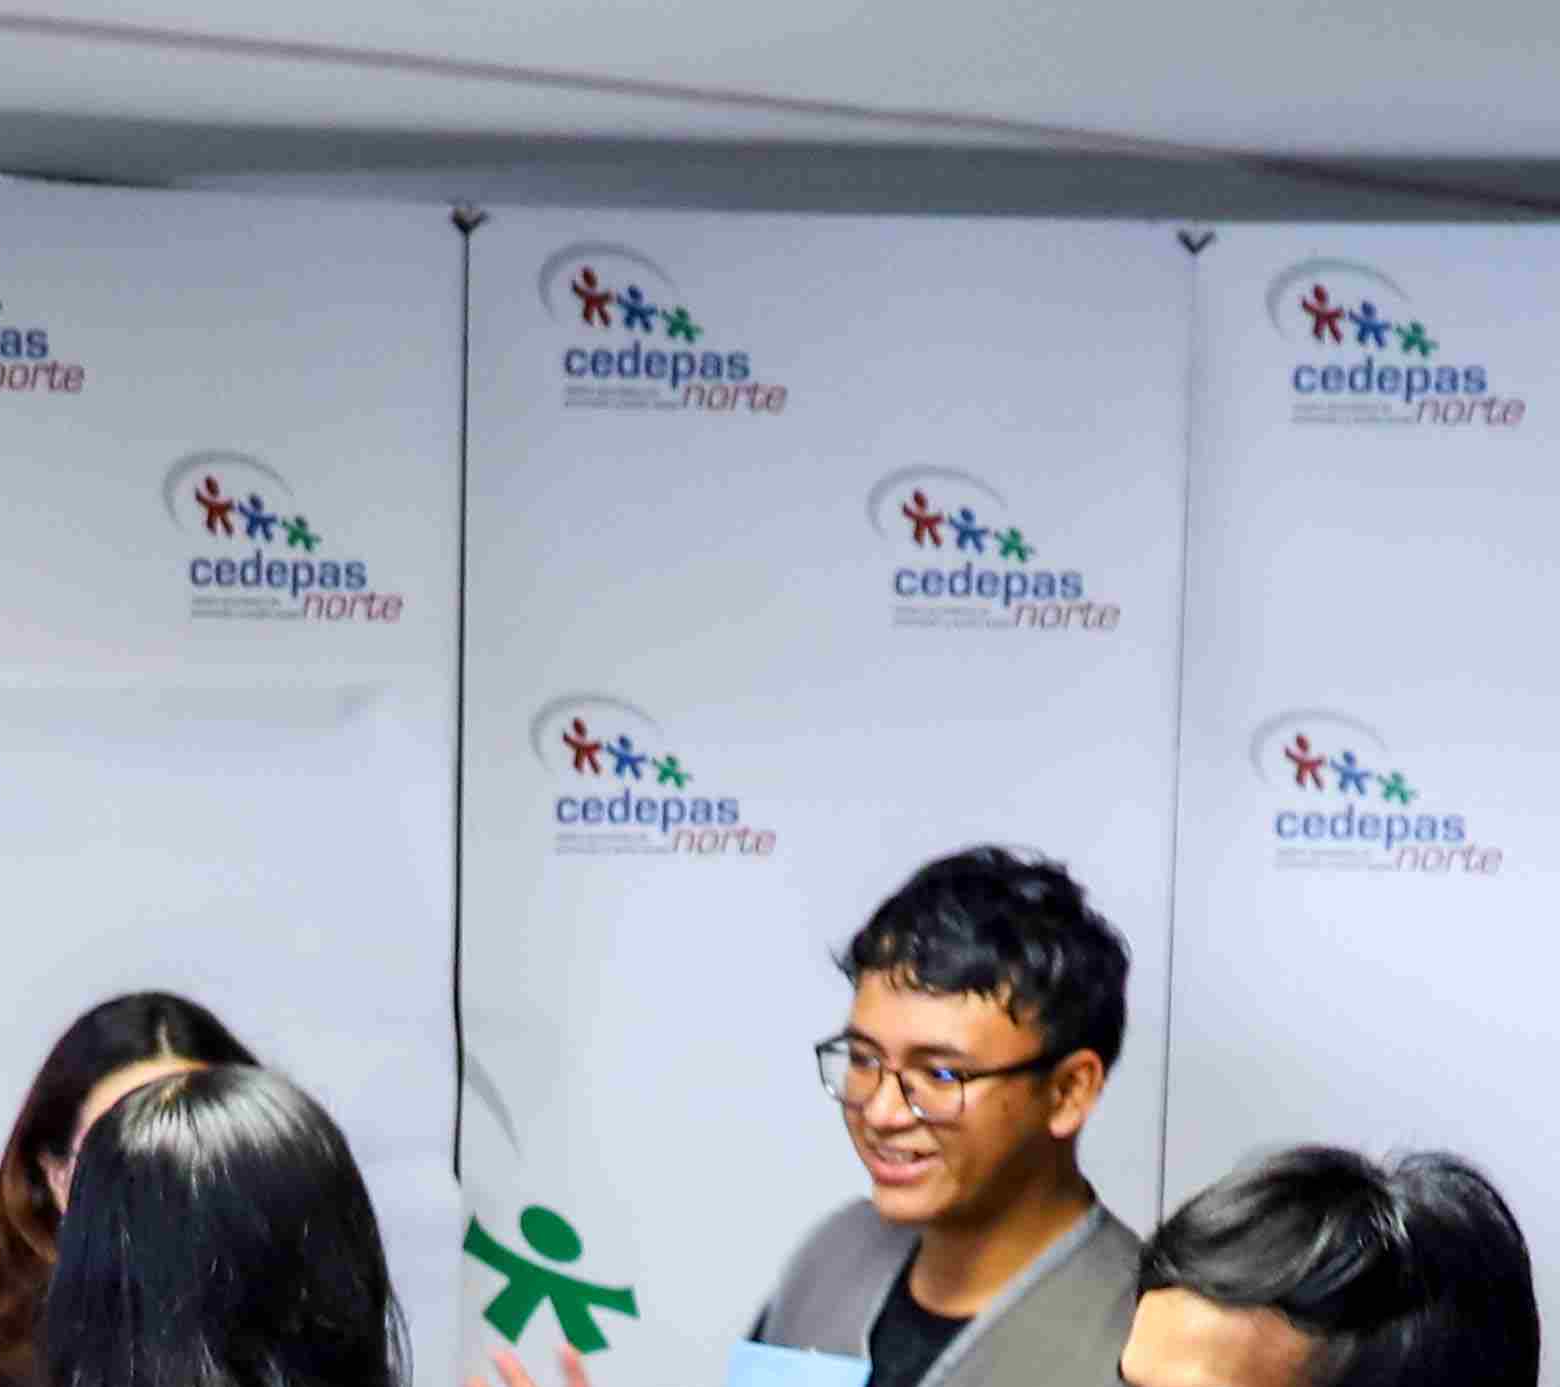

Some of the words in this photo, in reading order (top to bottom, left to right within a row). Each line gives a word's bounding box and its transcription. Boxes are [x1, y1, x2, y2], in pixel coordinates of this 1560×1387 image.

[564, 344, 751, 388] cedepas
[1292, 357, 1486, 403] cedepas
[682, 378, 787, 414] norte
[1415, 391, 1525, 429] norte
[189, 550, 367, 597] cedepas
[893, 563, 1083, 606] cedepas
[303, 589, 404, 623] norte
[1015, 597, 1120, 632] norte
[555, 790, 739, 833] cedepas
[1275, 806, 1465, 850] cedepas
[672, 824, 776, 858] norte
[1395, 840, 1502, 875] norte
